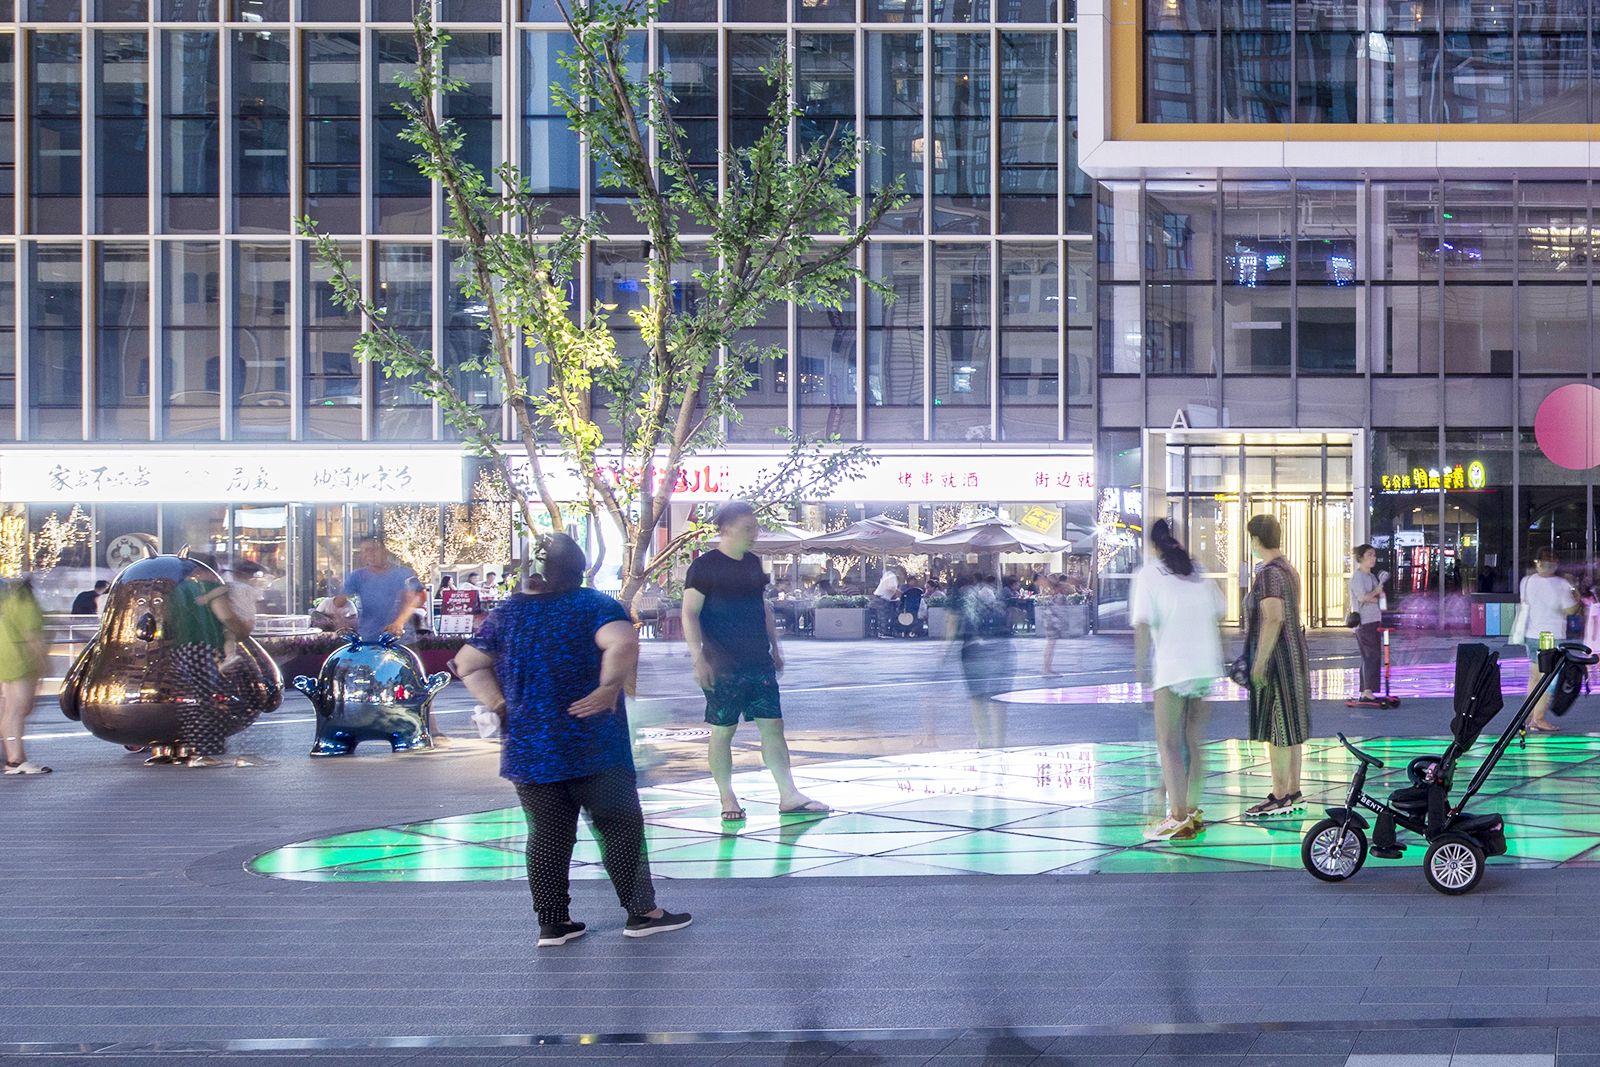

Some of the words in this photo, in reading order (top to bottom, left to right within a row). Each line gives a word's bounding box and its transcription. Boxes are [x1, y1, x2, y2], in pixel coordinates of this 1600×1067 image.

[1170, 408, 1188, 429] A
[898, 471, 978, 488] 烤串就酒
